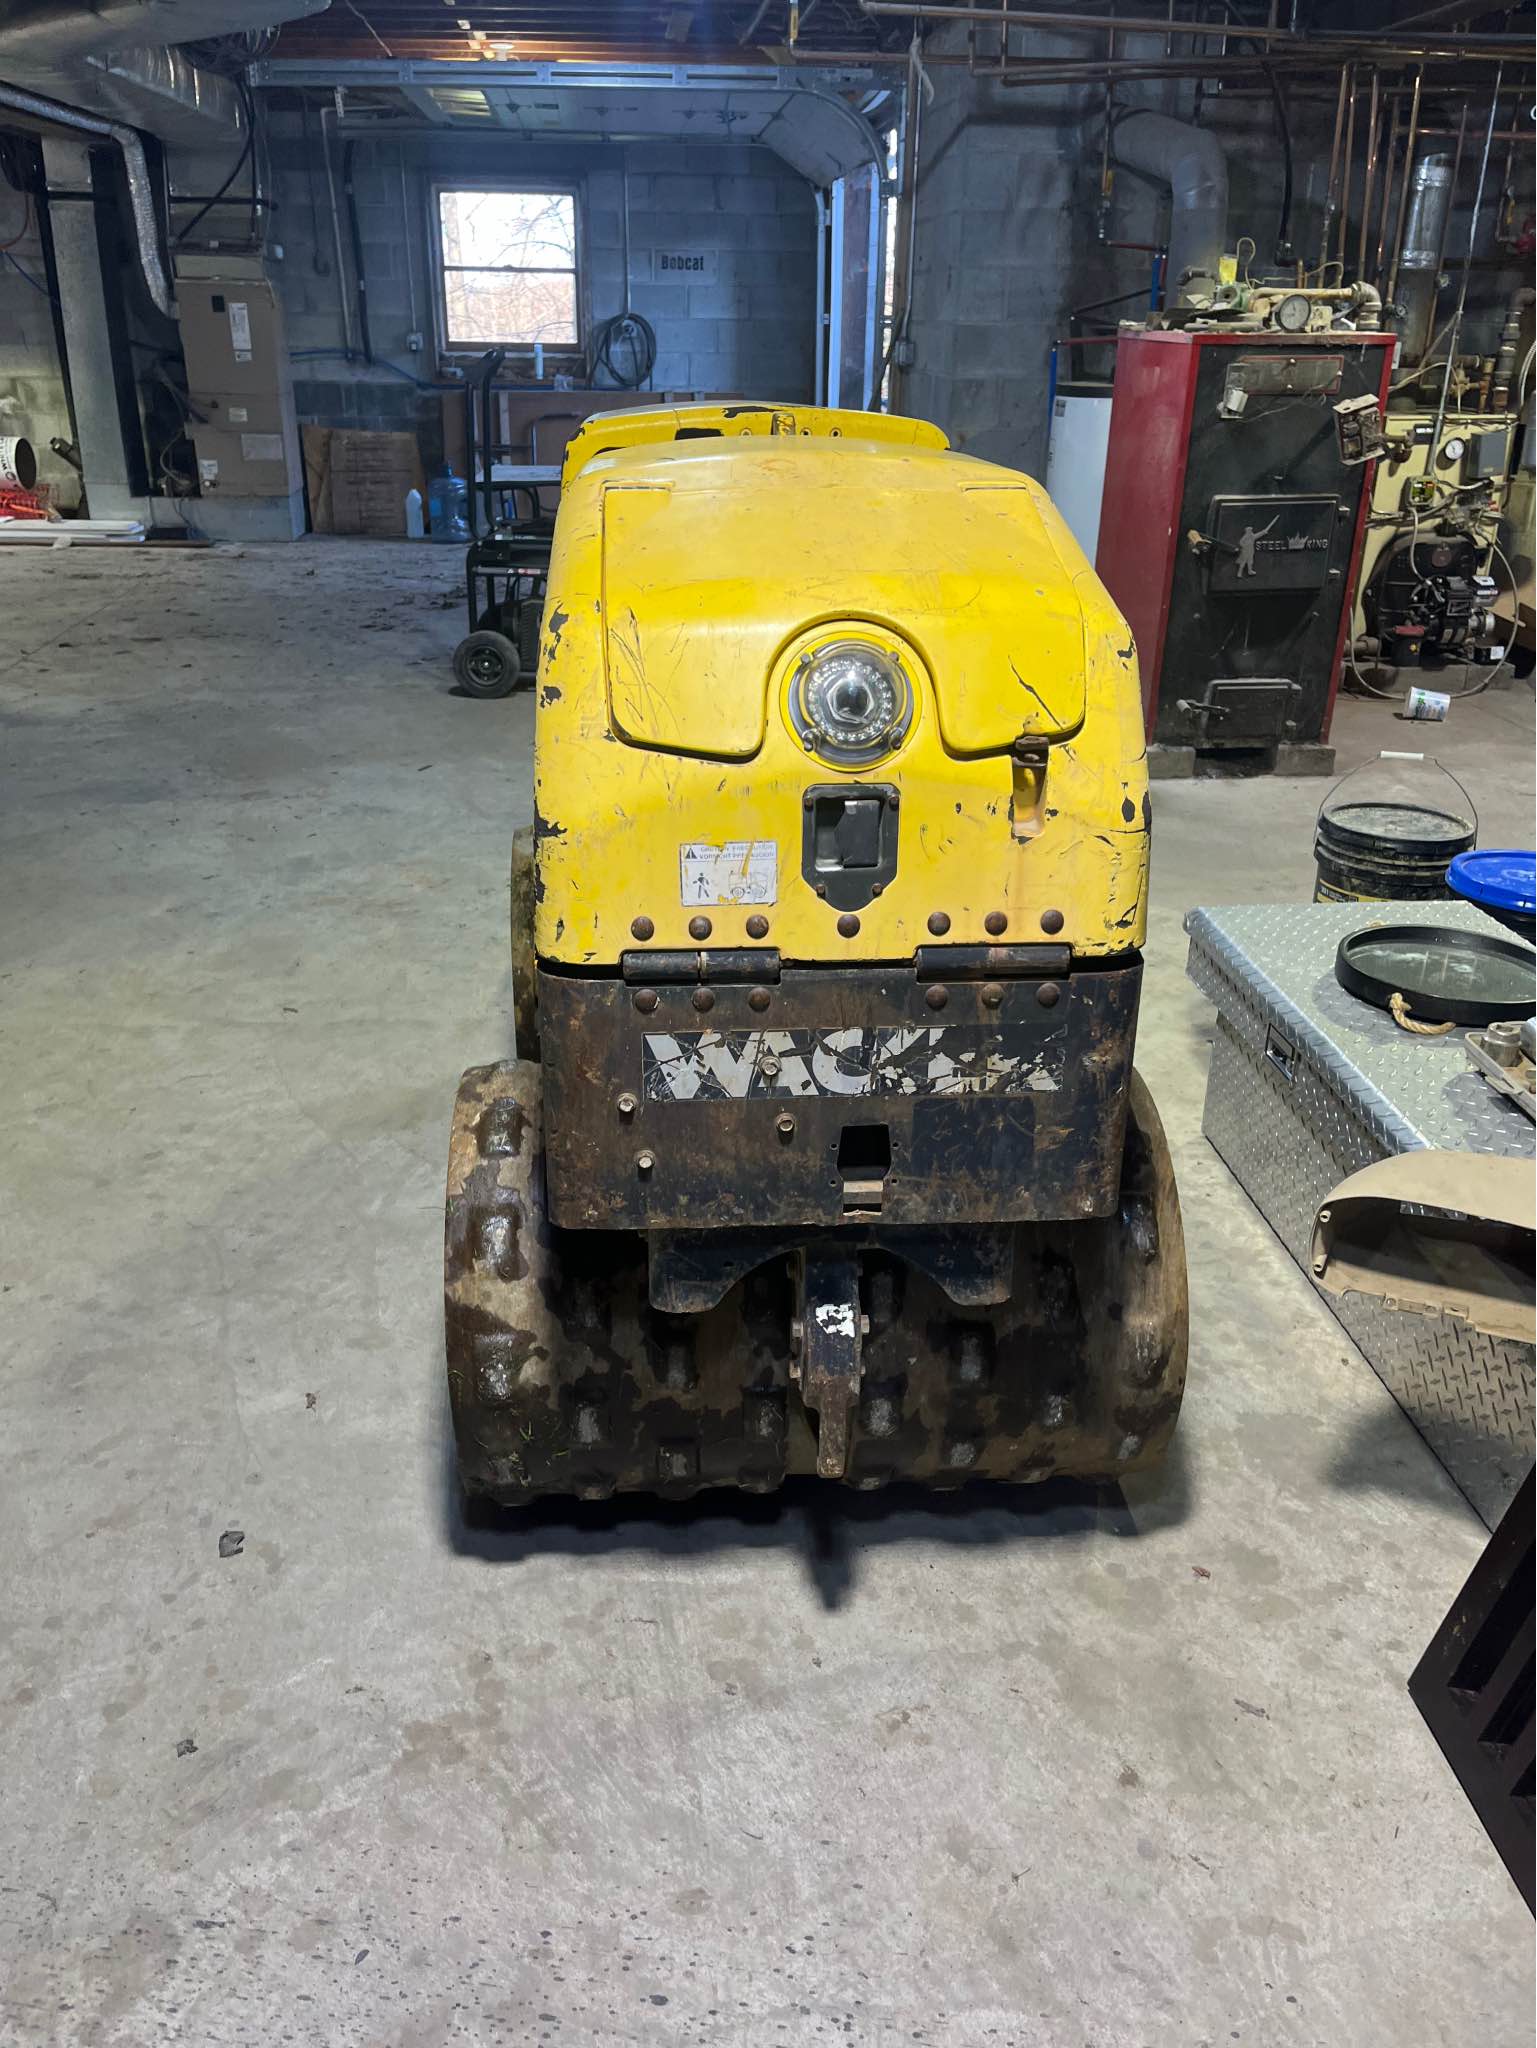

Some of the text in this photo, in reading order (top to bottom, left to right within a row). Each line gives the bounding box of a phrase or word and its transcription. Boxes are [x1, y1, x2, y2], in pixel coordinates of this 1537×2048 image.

[661, 256, 704, 271] Bobcat
[1256, 539, 1328, 551] STEEL KING
